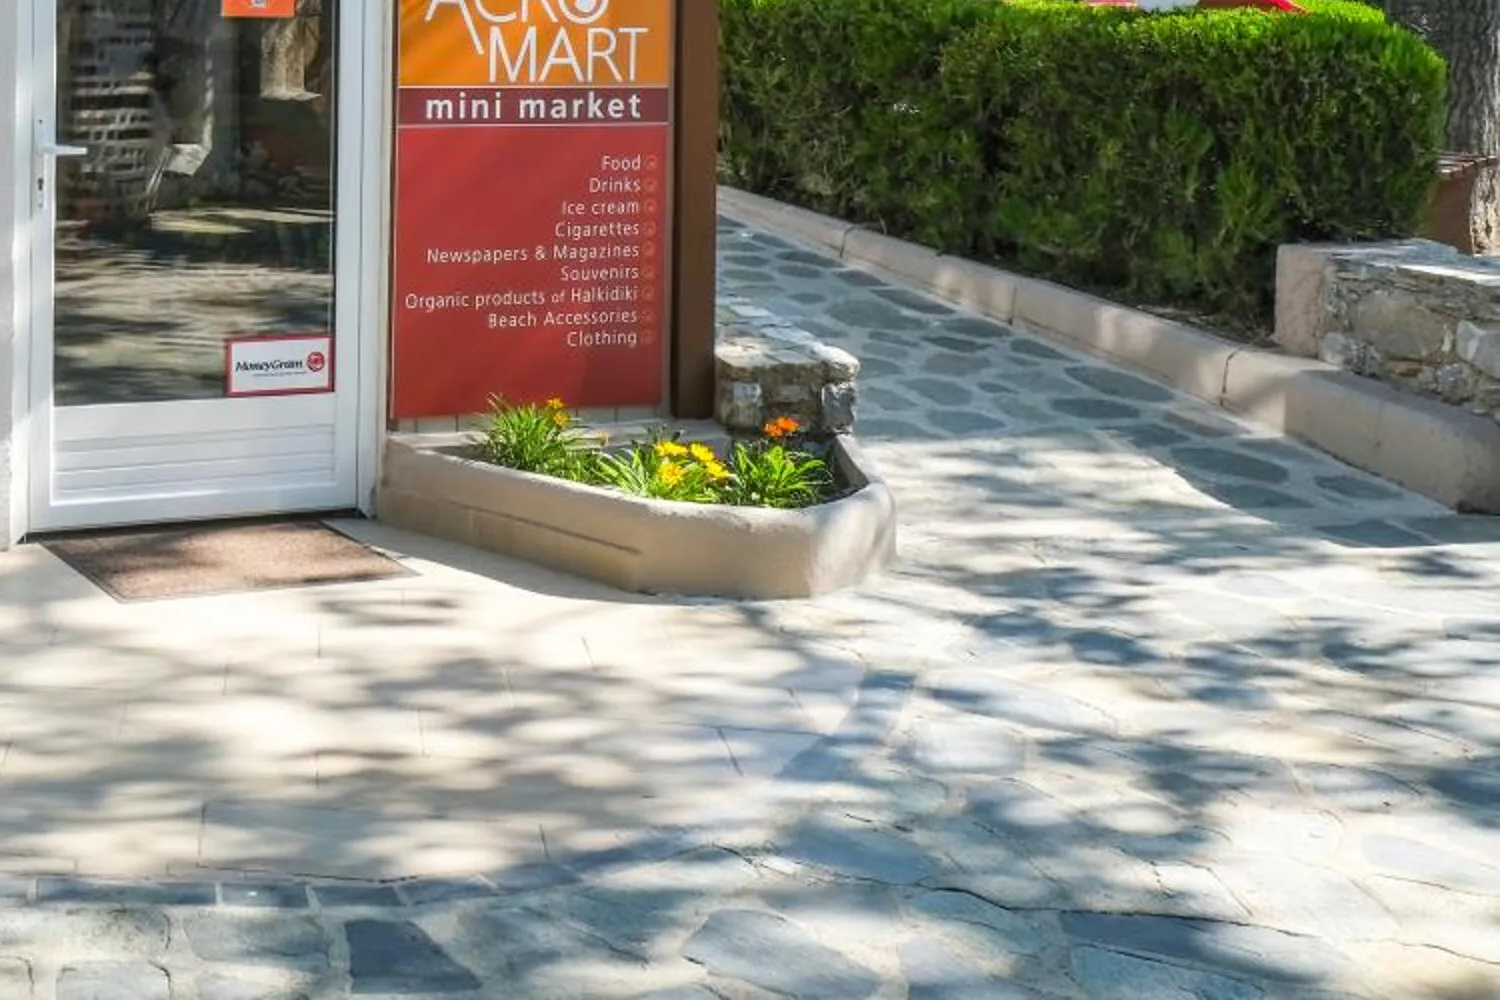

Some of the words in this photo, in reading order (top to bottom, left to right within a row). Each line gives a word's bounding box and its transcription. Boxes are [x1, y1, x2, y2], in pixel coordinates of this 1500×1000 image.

[488, 25, 650, 83] MART
[425, 92, 502, 119] mini
[518, 90, 642, 118] market
[601, 155, 642, 171] Food
[589, 177, 641, 193] Drinks
[561, 201, 585, 215] Ice
[591, 201, 640, 215] cream
[555, 222, 640, 241] Cigarettes
[426, 247, 528, 266] Newspapers
[534, 245, 547, 261] &
[553, 244, 640, 262] Magazines
[560, 266, 639, 282] Souvenirs
[405, 292, 469, 313] Organic
[475, 289, 545, 310] products
[551, 290, 567, 303] of
[571, 285, 638, 303] Halkidiki
[488, 311, 537, 328] Beach
[543, 307, 637, 326] Accessories
[566, 329, 637, 348] Clothing
